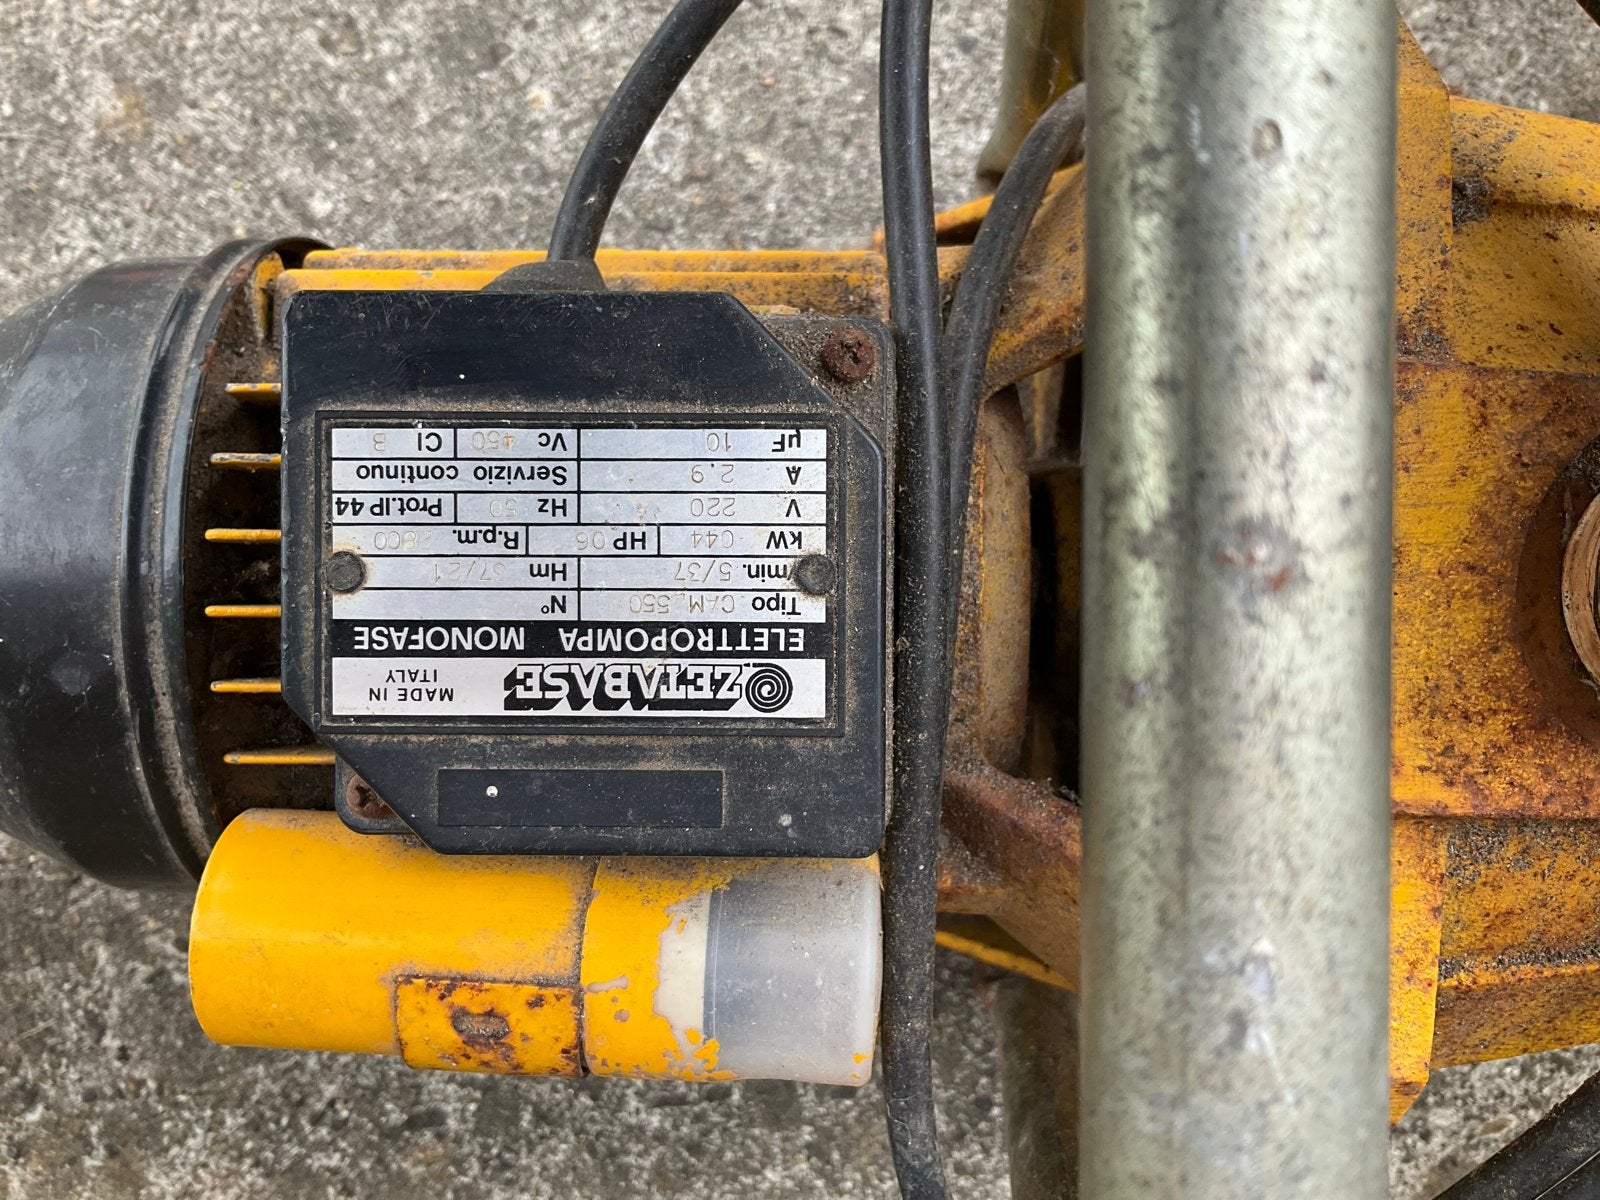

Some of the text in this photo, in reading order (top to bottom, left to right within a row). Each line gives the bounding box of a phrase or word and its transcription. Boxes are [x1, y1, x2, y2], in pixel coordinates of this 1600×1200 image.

[473, 431, 567, 451] Vc 450
[707, 433, 731, 452] 10
[356, 465, 567, 485] Servizio continuo
[691, 464, 801, 485] A 2.9
[335, 497, 364, 516] 44
[490, 499, 567, 518] Hz 50
[691, 498, 801, 517] V 220
[453, 527, 518, 549] R.p.m.
[576, 532, 646, 550] HP 06
[766, 531, 802, 549] kW
[530, 564, 567, 581] Hm
[674, 560, 732, 583] 5/37
[752, 593, 801, 615] Tipo
[354, 627, 804, 651] ELETTROPOMPA MONOFASE
[385, 670, 438, 683] ITALY
[369, 688, 453, 701] MADE IN
[504, 663, 746, 711] ZETABASE
